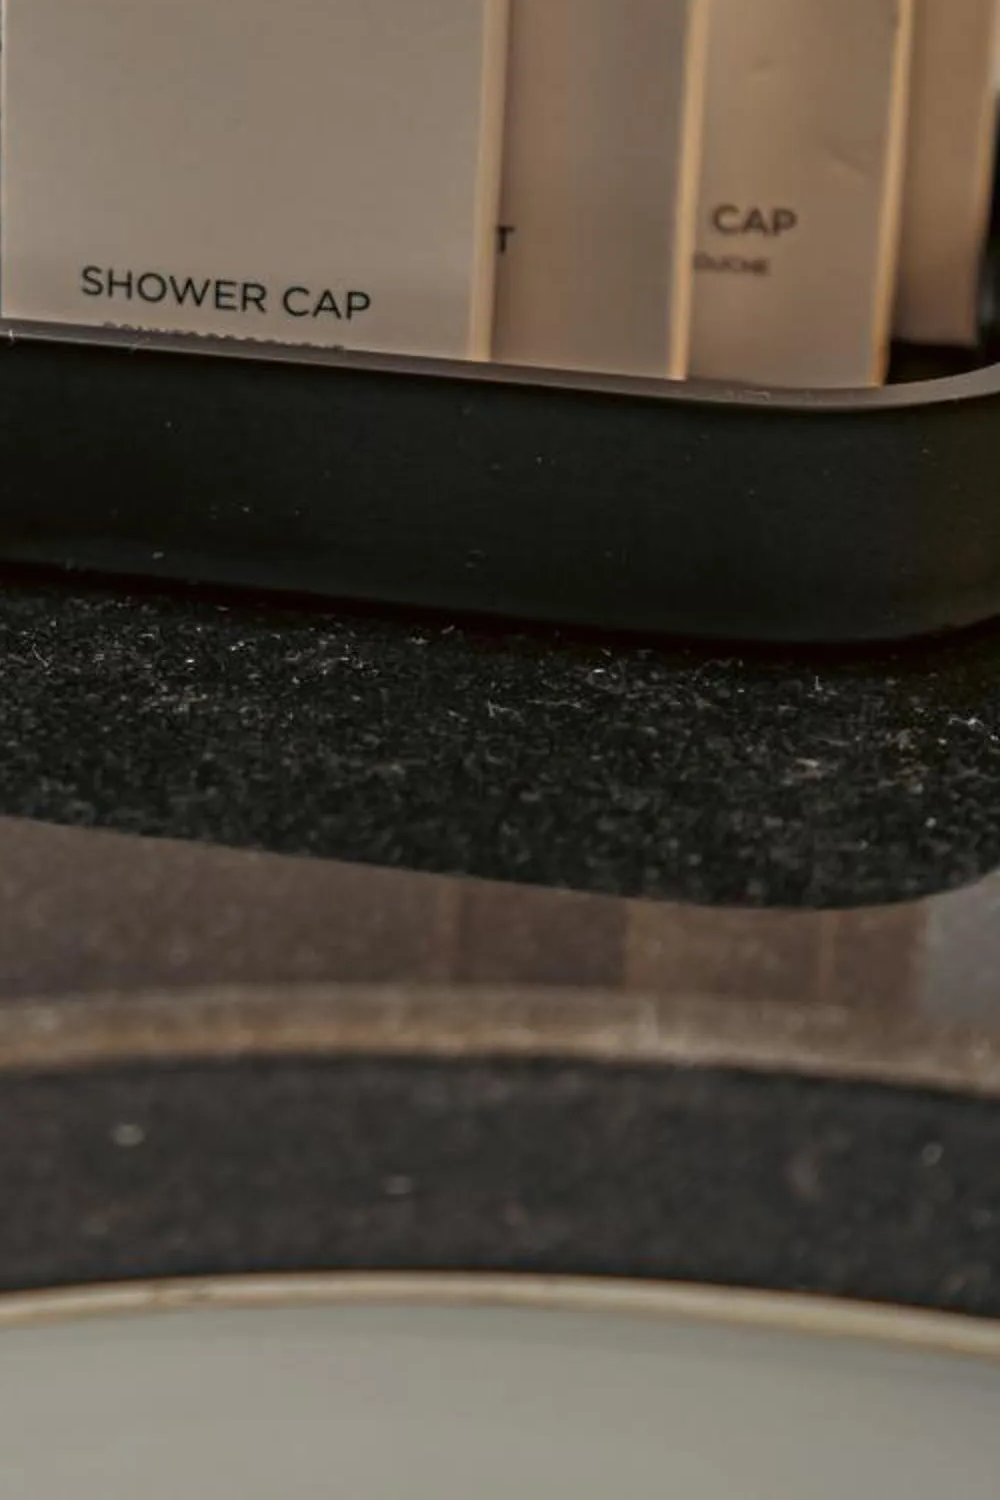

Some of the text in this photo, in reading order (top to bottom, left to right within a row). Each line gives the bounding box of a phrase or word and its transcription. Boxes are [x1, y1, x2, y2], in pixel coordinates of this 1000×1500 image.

[711, 203, 798, 238] CAP
[81, 265, 372, 320] SHOWER CAP
